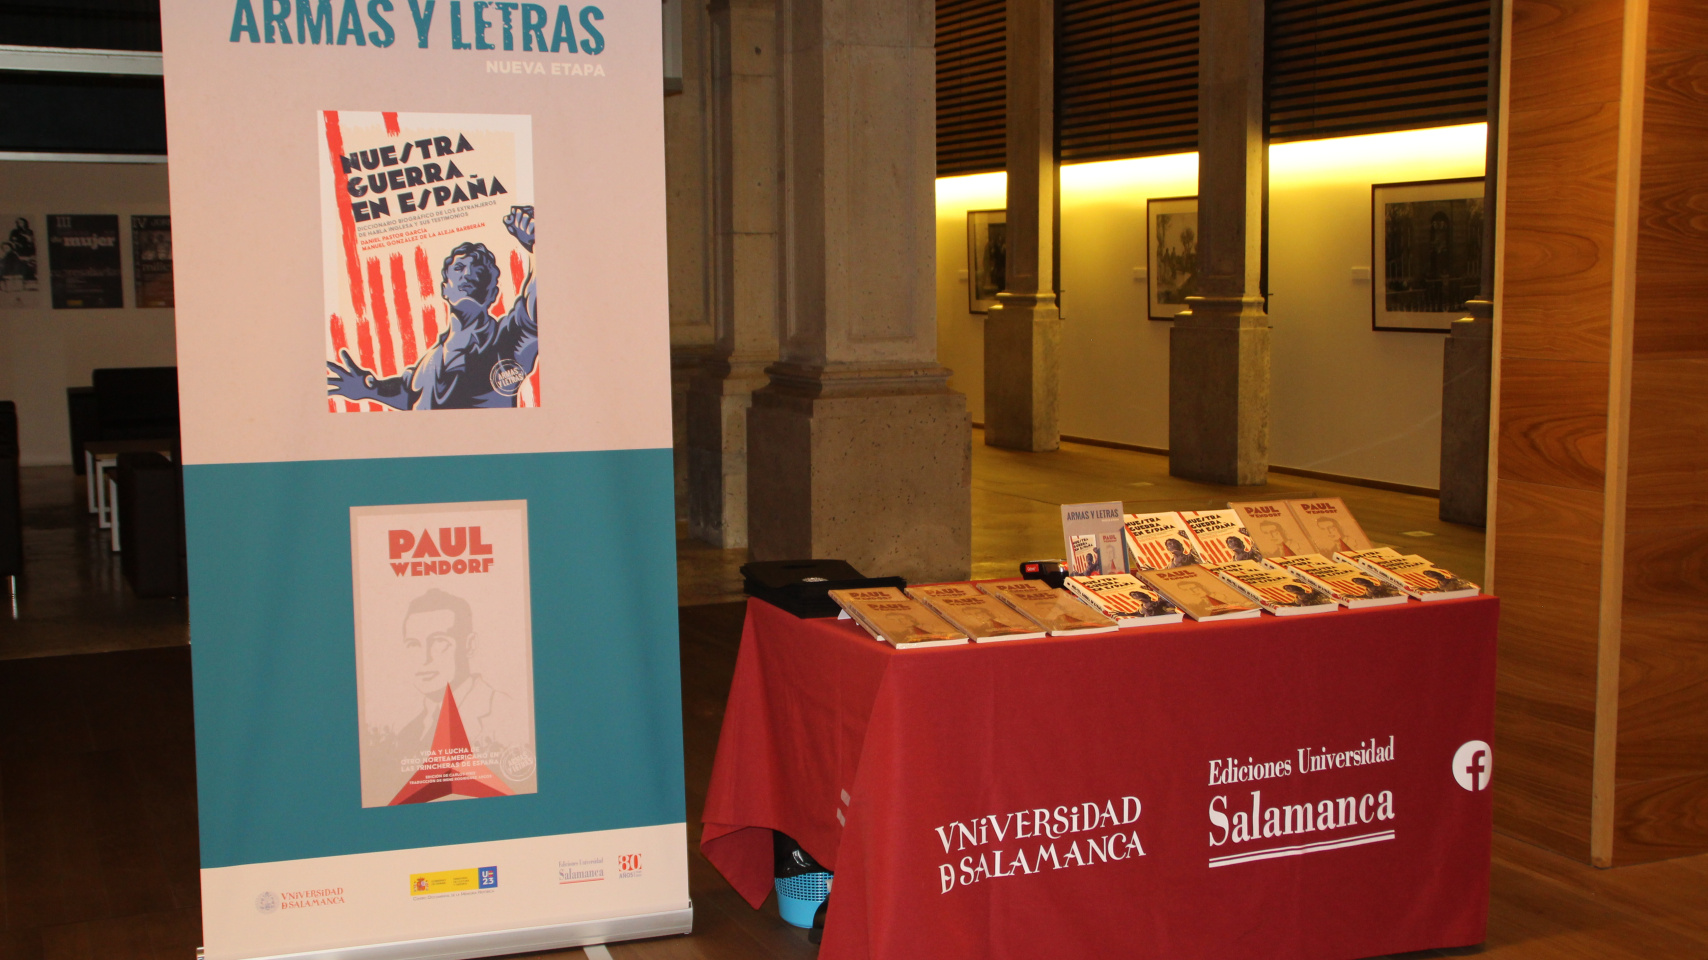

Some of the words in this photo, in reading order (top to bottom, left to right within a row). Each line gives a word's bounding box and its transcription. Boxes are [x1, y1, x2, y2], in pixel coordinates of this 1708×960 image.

[229, 0, 396, 49] ARMAS
[407, 0, 436, 49] Y
[451, 0, 606, 56] LETRAS
[486, 60, 546, 76] NUEVA
[551, 62, 606, 78] ETAPA
[338, 132, 475, 175] NUESTRA
[347, 159, 465, 198] GUERRA
[351, 197, 391, 223] EN
[397, 174, 508, 214] ESPAÑA
[357, 219, 397, 232] DICCIONARIO
[444, 207, 456, 215] LOS
[456, 200, 497, 212] EXTRANJEROS
[358, 230, 367, 238] DE
[367, 226, 387, 236] HABLA
[388, 222, 413, 232] INGLESA
[419, 218, 431, 226] SUS
[431, 211, 469, 224] TESTIMONIOS
[63, 234, 115, 249] mujer
[360, 236, 381, 246] DANIEL
[382, 232, 404, 242] PASTOR
[405, 227, 428, 238] GARCÍA
[361, 242, 386, 251] MANUEL
[387, 234, 419, 247] GONZÁLEZ
[437, 228, 456, 237] ALEJA
[456, 221, 486, 233] BARBERÁN
[1067, 510, 1090, 520] ARMAS
[1090, 510, 1095, 519] Y
[1096, 508, 1119, 518] LETRAS
[388, 526, 493, 559] PAUL
[389, 557, 495, 577] WENDORF
[1156, 570, 1195, 578] PAUL
[401, 757, 421, 766] OTRO
[422, 752, 488, 764] NORTEAMERICANO
[444, 747, 469, 755] LUCHA
[416, 761, 460, 771] TRINCHERAS
[472, 758, 499, 766] ESPAÑA
[1208, 757, 1292, 787] Ediciones
[1297, 735, 1395, 775] Universidad
[1208, 790, 1395, 847] Salamanca
[618, 853, 643, 872] 80
[959, 830, 1147, 885] SALAMANCA
[482, 877, 494, 885] 23
[559, 868, 604, 880] Salamanca
[289, 897, 345, 908] SALAMANCA
